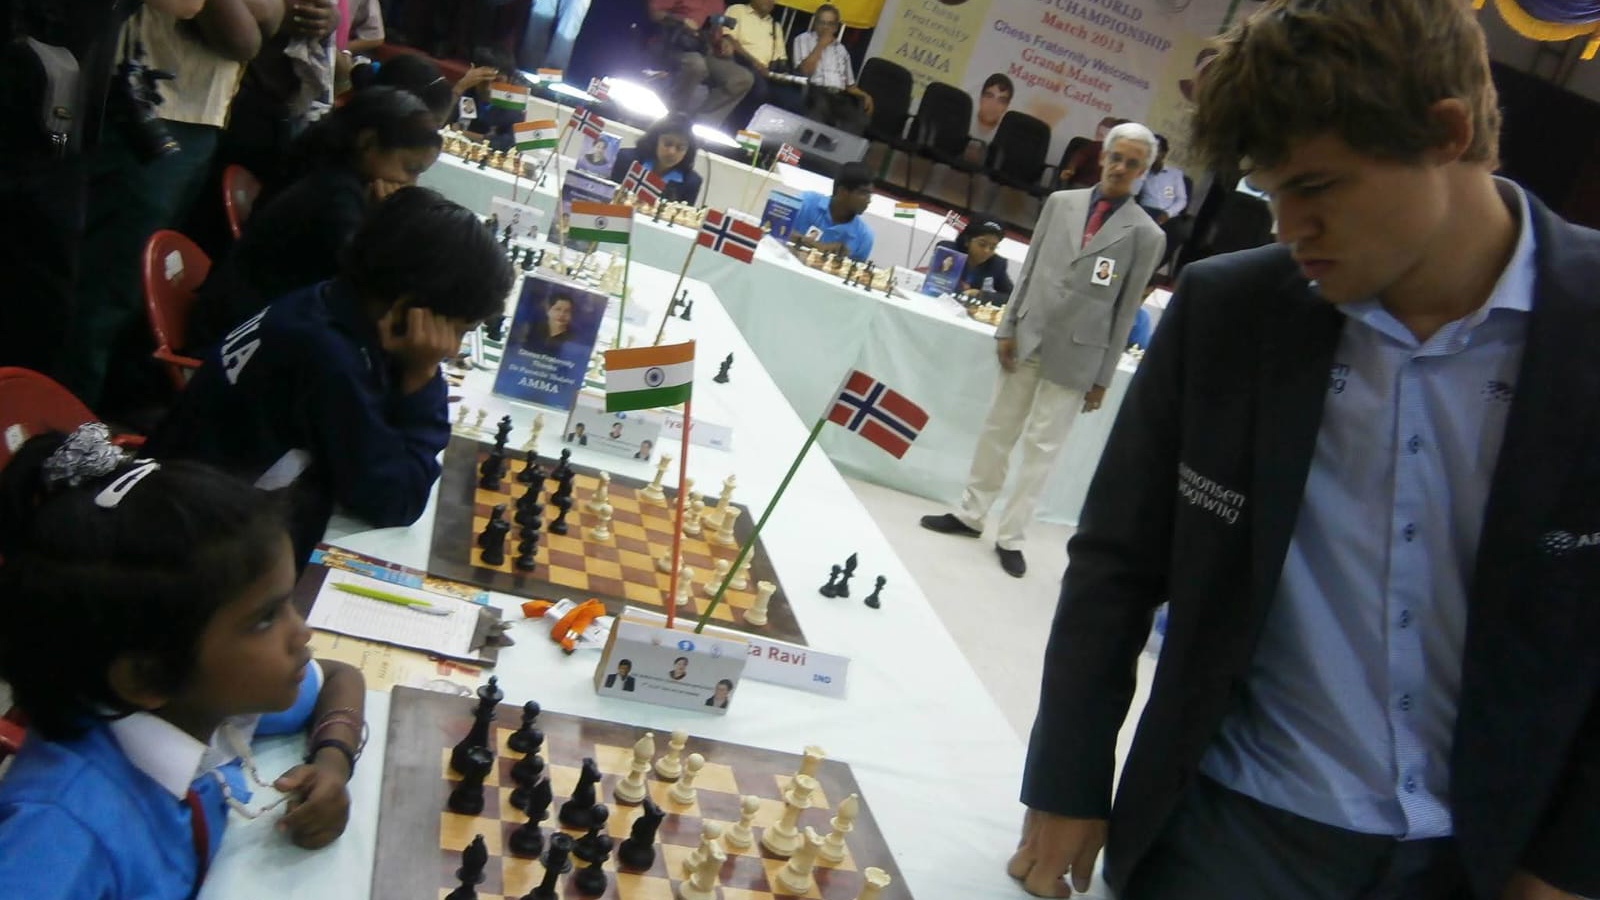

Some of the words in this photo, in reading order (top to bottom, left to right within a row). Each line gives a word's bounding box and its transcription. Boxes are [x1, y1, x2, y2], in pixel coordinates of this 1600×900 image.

[904, 9, 969, 42] Fraternity
[922, 0, 961, 21] Chess
[1055, 0, 1171, 51] CHAMPIONSHIP
[907, 26, 954, 53] Thanks
[1041, 12, 1088, 40] Match
[1092, 31, 1125, 54] 2013
[895, 41, 951, 73] AMMA
[993, 19, 1031, 43] Chess
[1033, 35, 1090, 68] Fraternity
[1091, 59, 1150, 90] Welcomes
[1021, 48, 1066, 74] Grand
[1068, 67, 1113, 93] Master
[1008, 62, 1062, 92] Magnus
[1063, 84, 1113, 113] Carlsen
[517, 376, 560, 394] AMMA
[768, 646, 807, 666] Ravi
